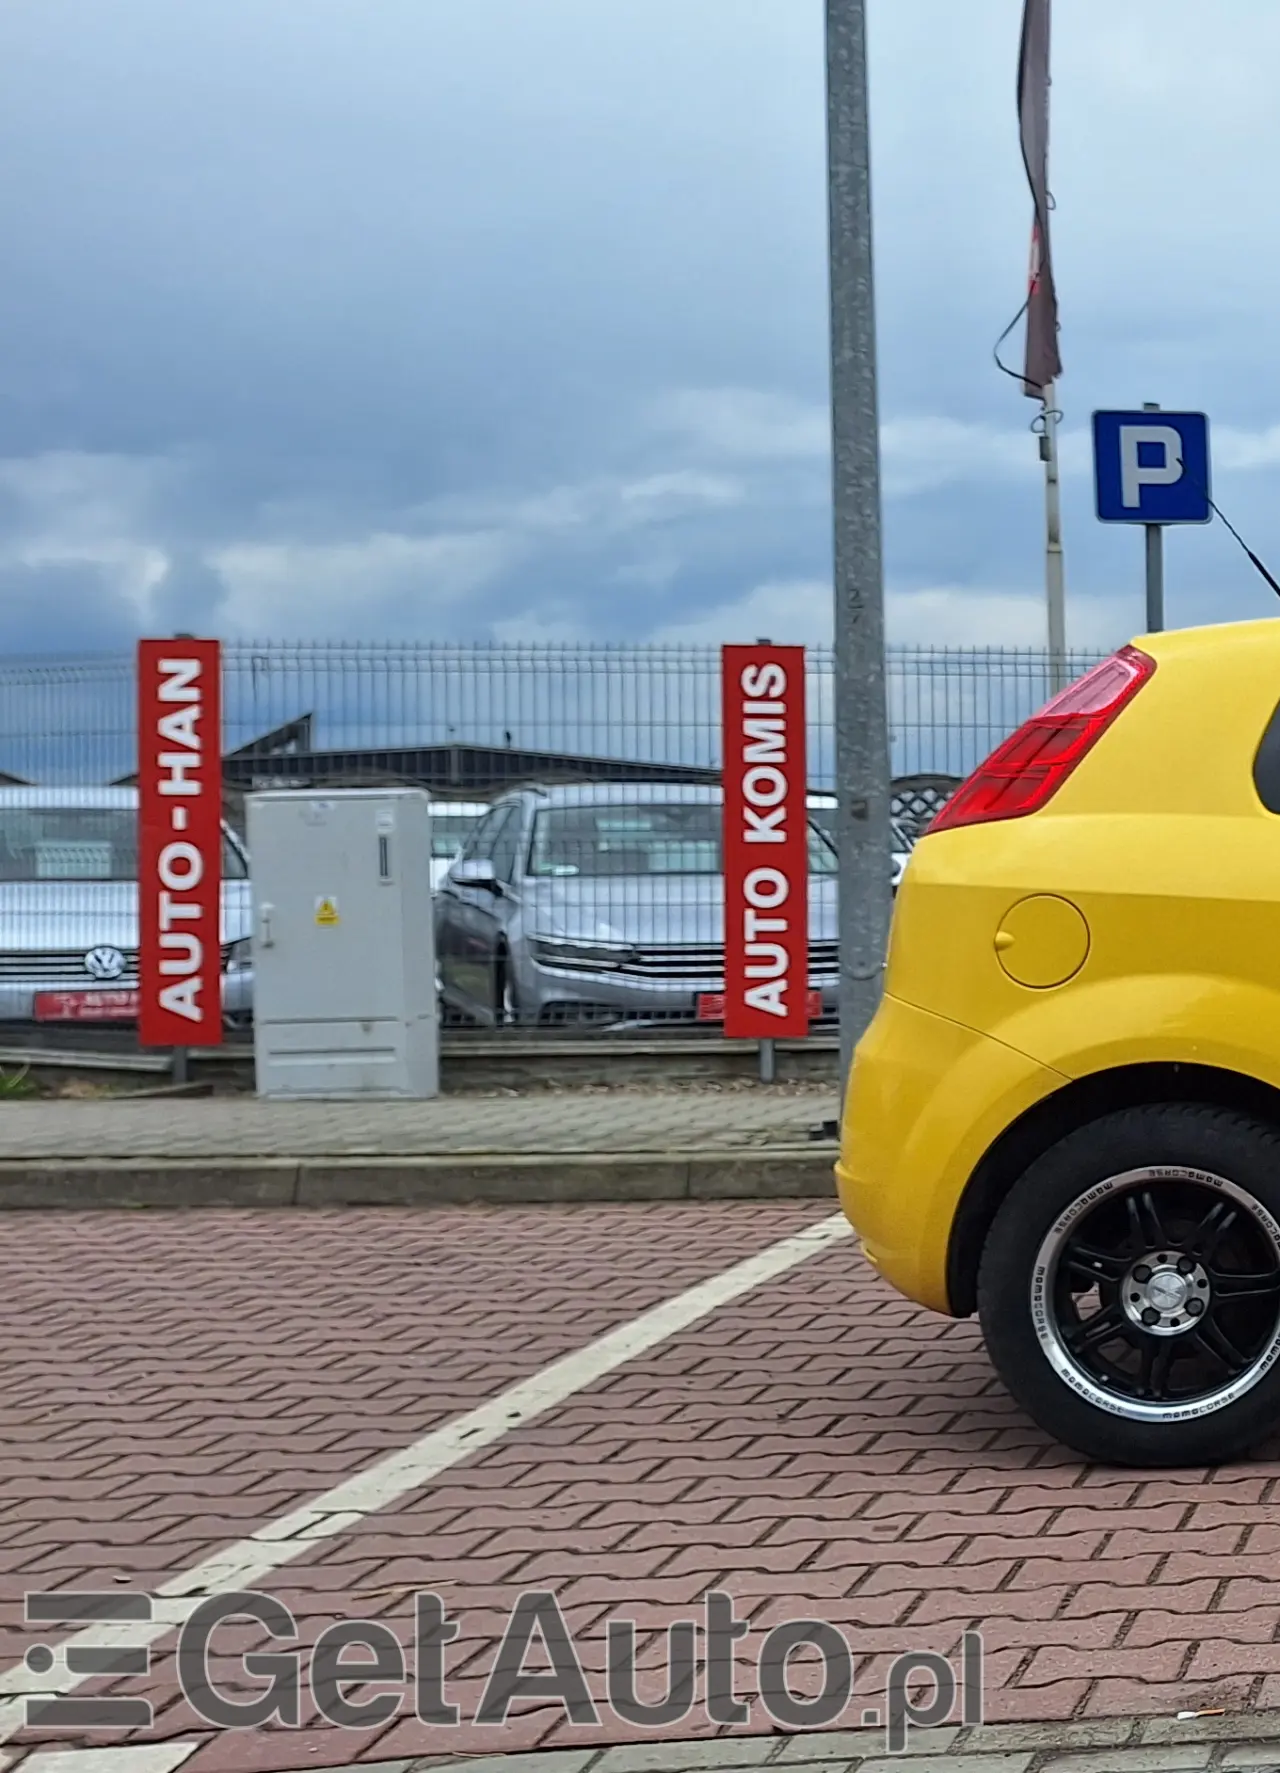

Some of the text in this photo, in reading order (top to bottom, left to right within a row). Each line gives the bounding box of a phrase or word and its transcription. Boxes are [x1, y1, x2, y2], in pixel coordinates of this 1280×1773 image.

[1120, 425, 1183, 508] P
[159, 659, 202, 1020] AUTO-HAN
[742, 664, 788, 1016] AUTO KOMIS
